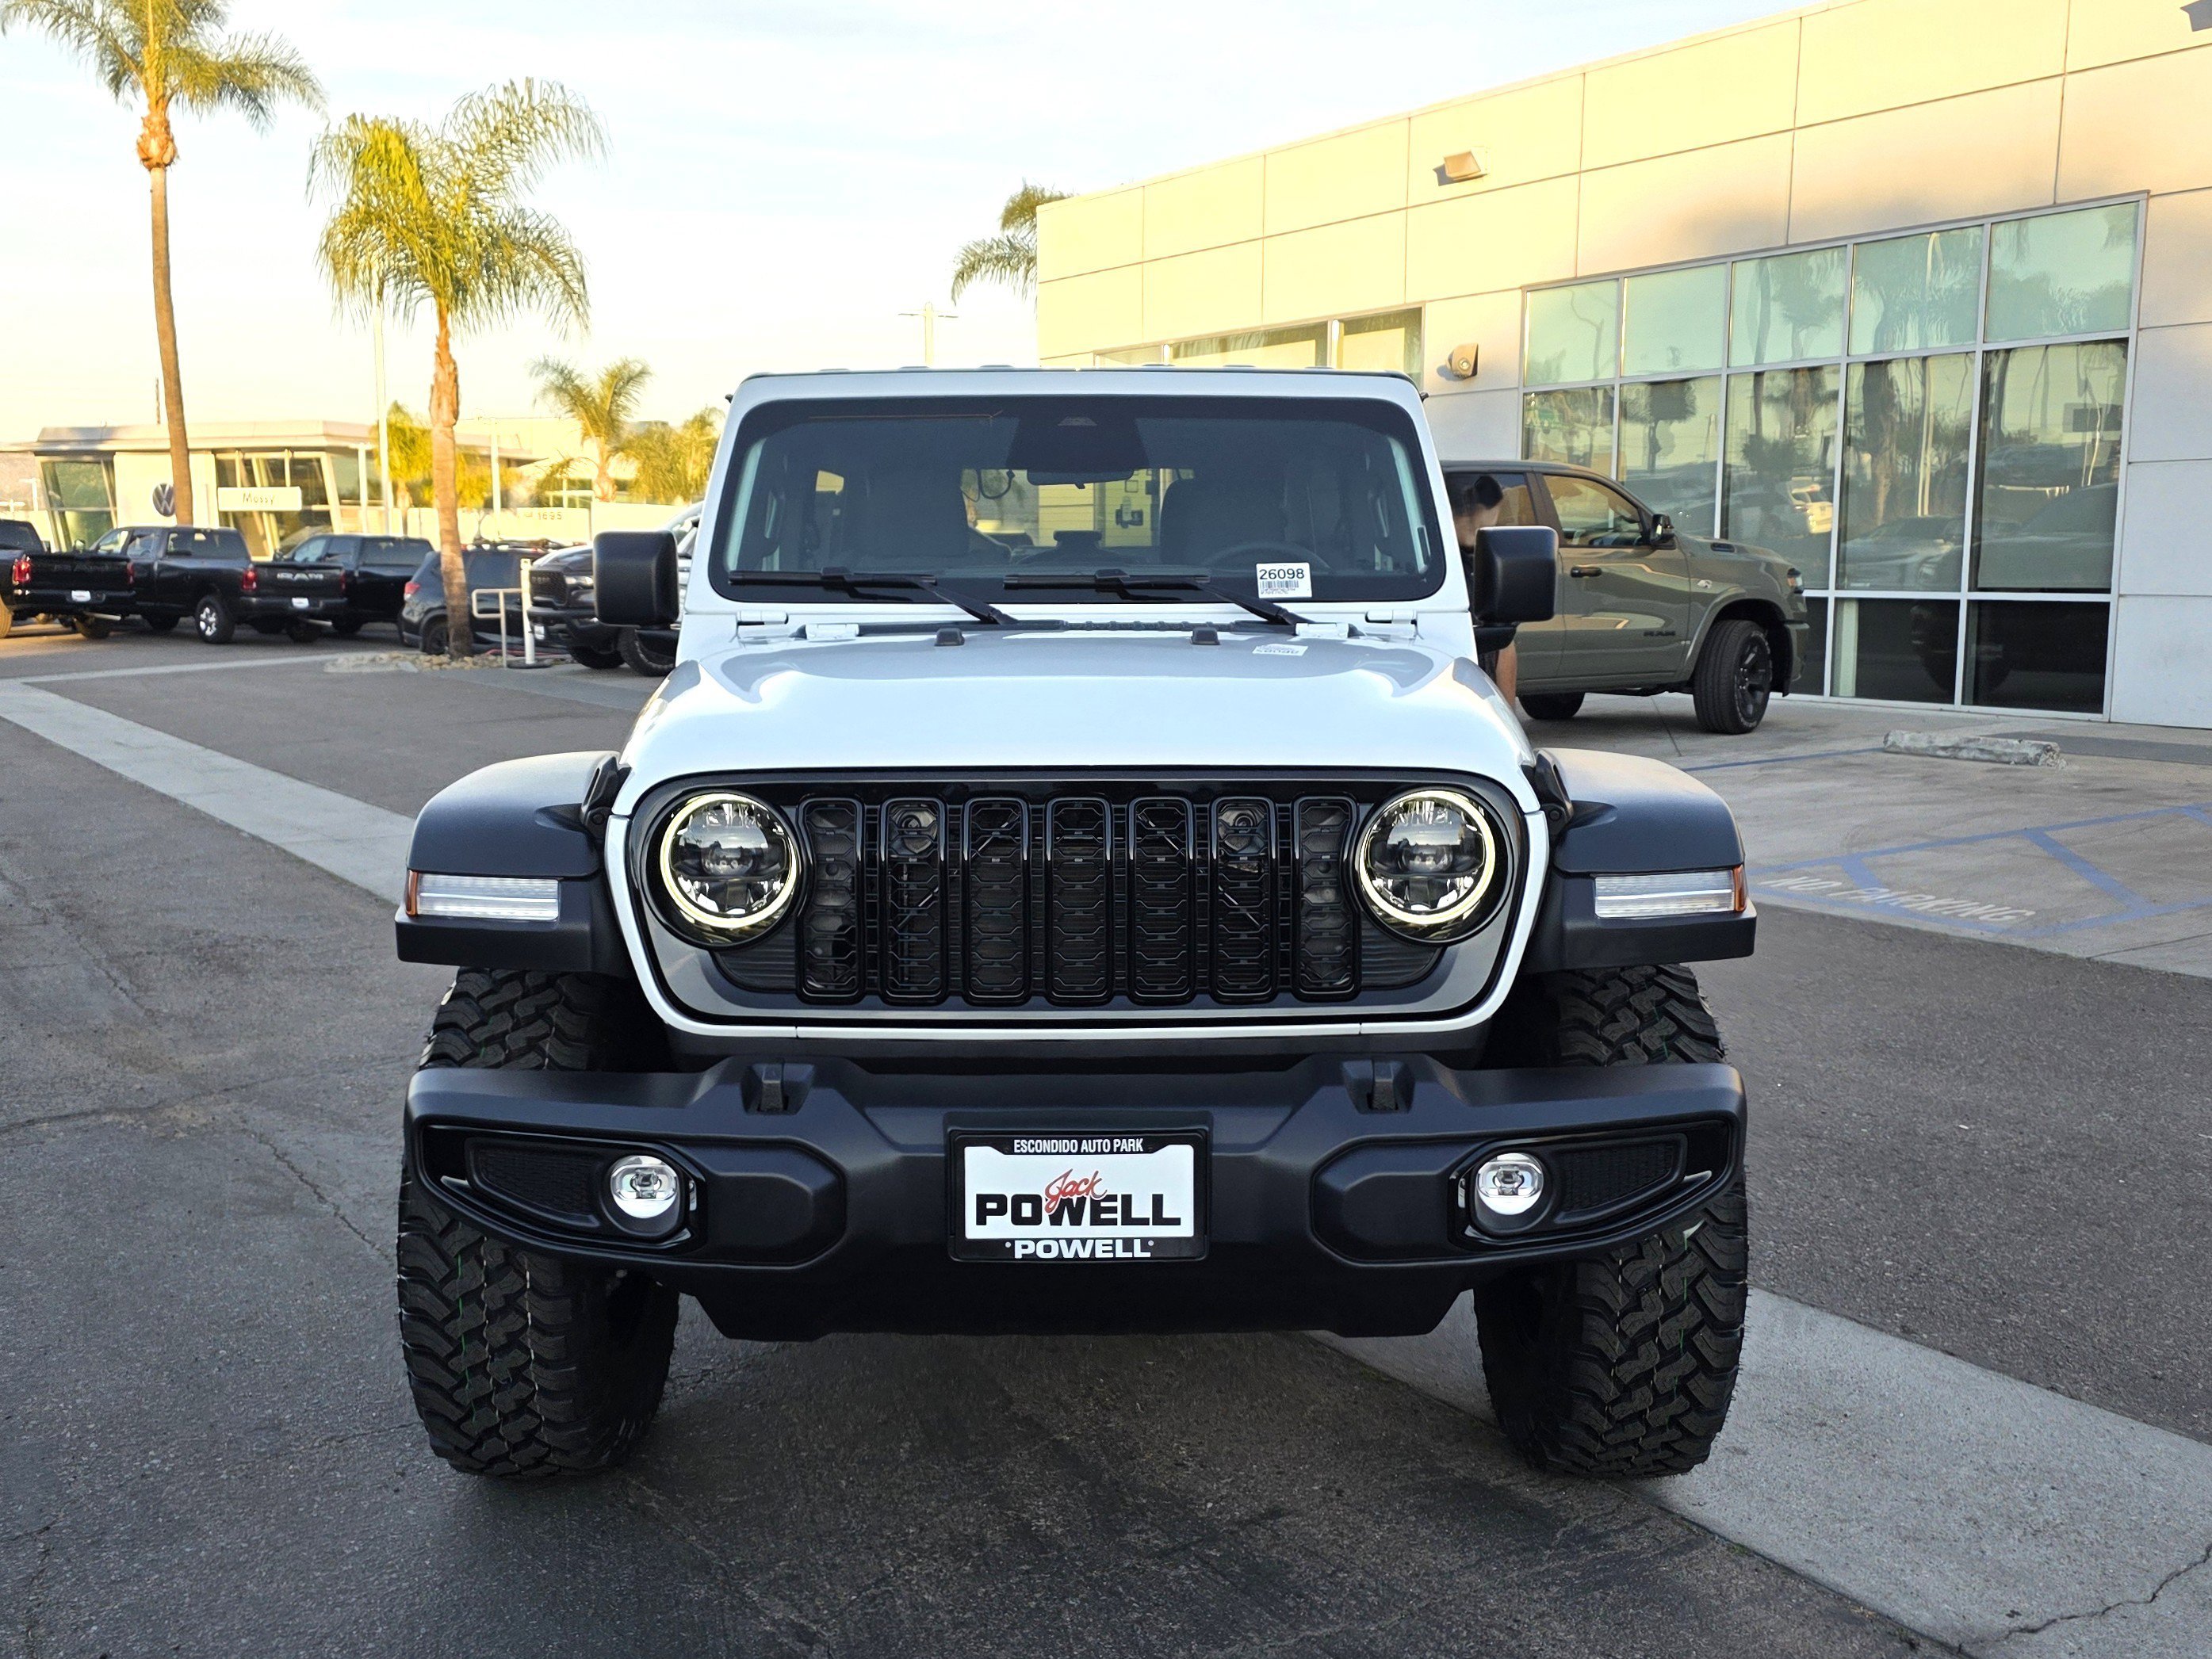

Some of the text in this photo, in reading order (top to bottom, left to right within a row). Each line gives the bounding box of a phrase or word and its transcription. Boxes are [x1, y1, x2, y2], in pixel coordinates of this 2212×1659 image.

[243, 492, 275, 505] Mossy
[277, 572, 324, 581] RAM
[1259, 568, 1305, 580] 26098
[1756, 875, 2038, 922] NO PARKING
[1013, 1137, 1144, 1153] ESCONDIDO AUTO PARK
[1044, 1168, 1109, 1214] Jack
[975, 1193, 1181, 1226] POWELL
[1014, 1238, 1151, 1259] POWELL
